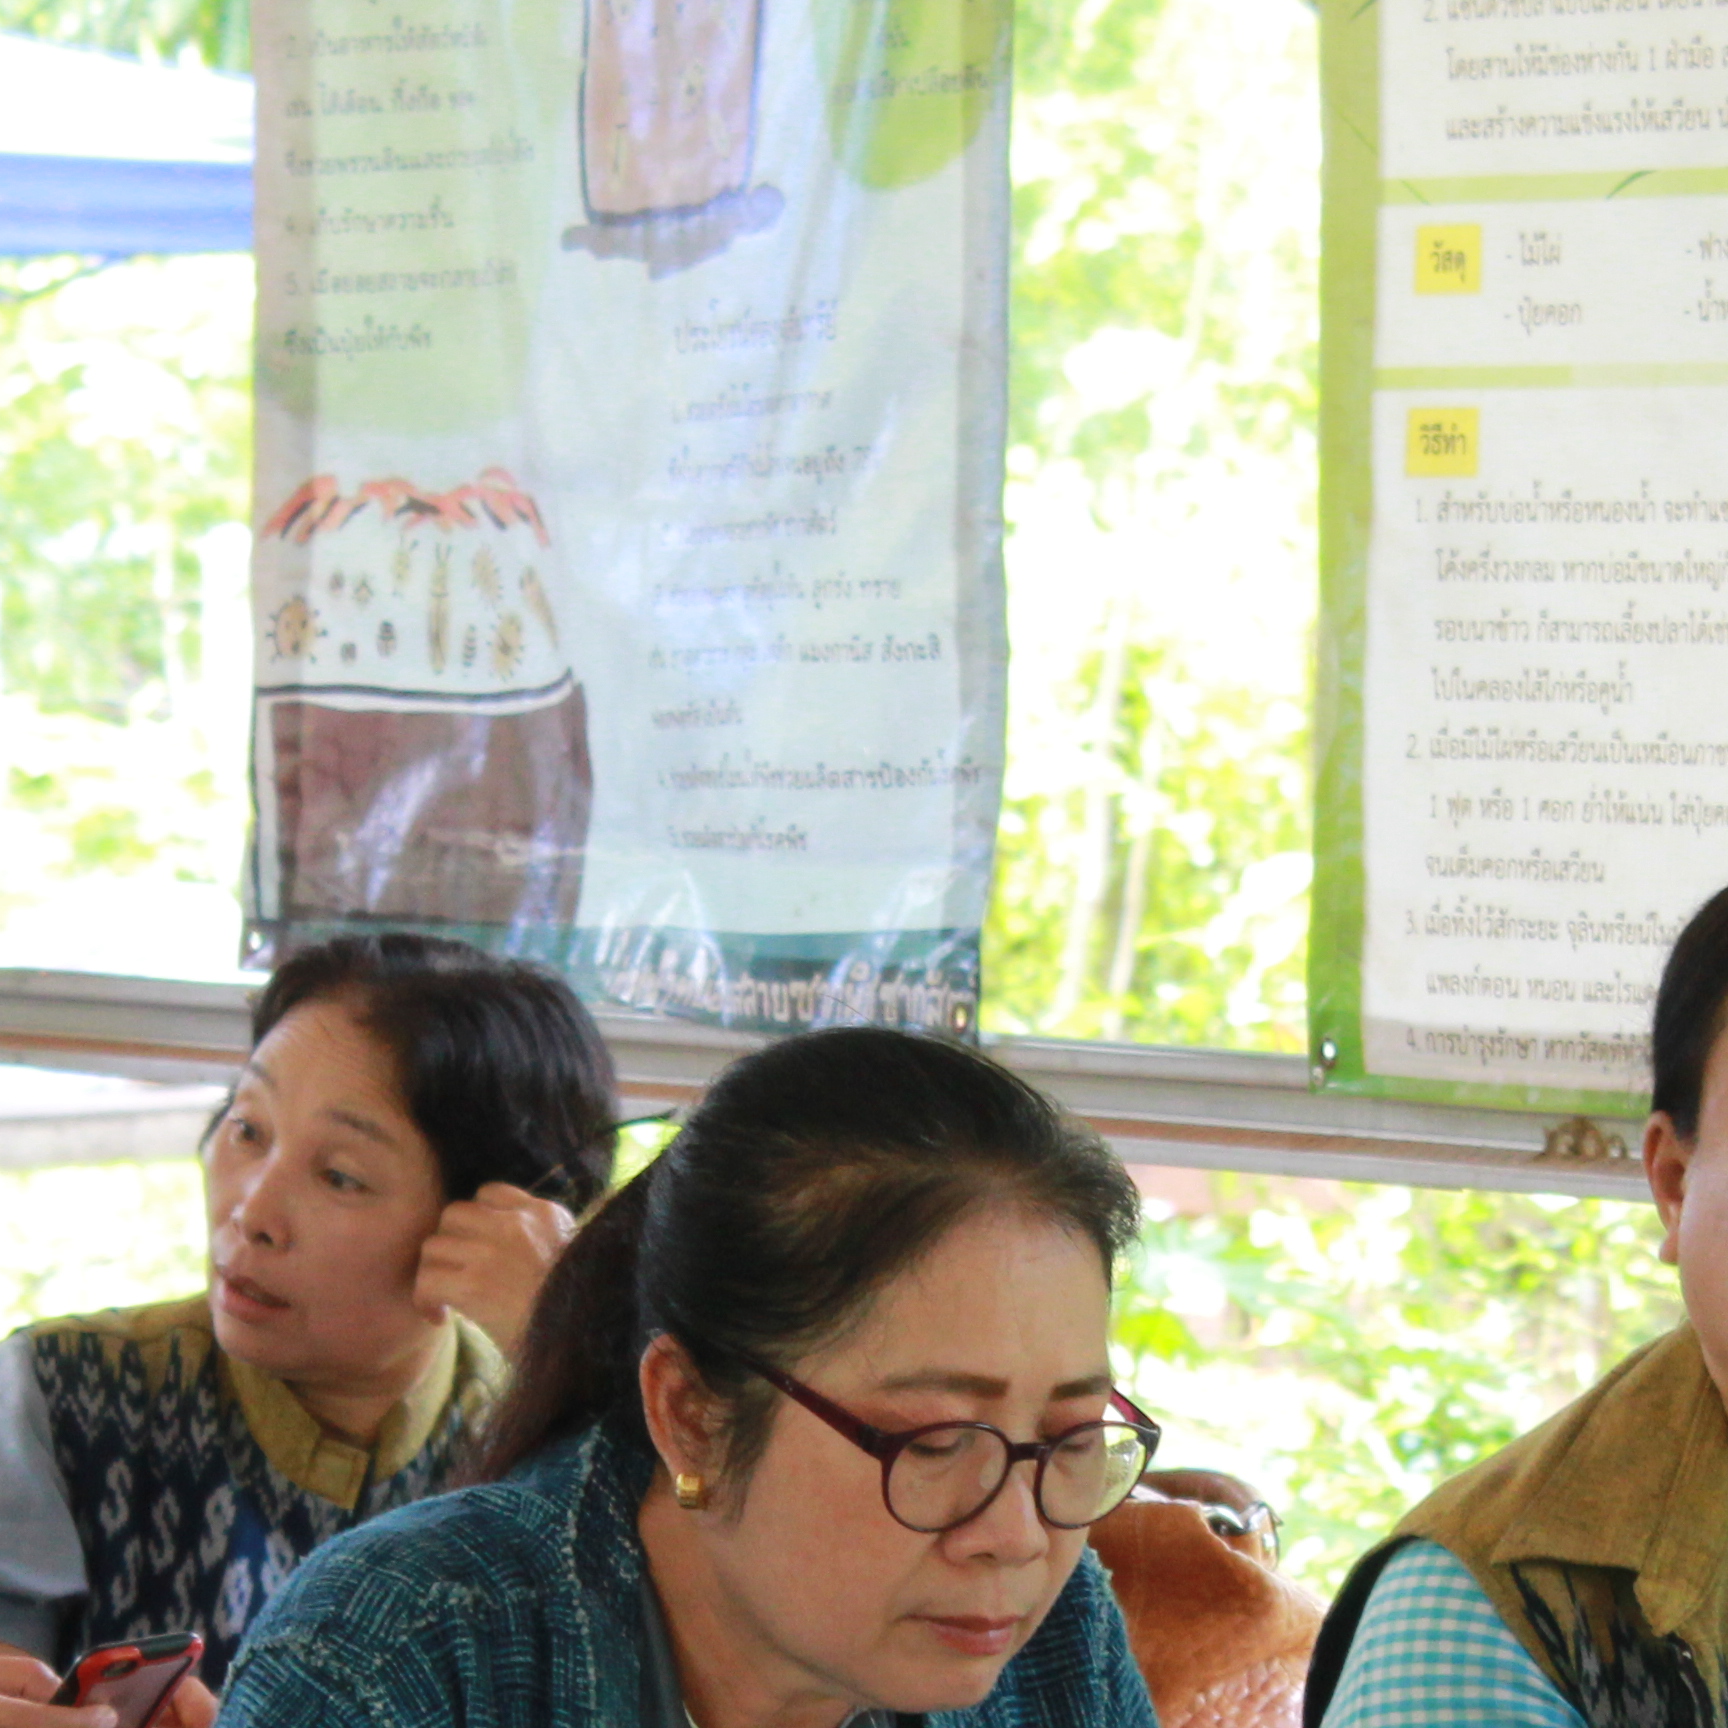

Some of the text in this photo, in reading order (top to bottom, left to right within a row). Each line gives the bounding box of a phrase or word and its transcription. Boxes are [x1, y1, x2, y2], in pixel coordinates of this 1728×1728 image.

[1649, 45, 1657, 72] 1
[1429, 238, 1466, 285] วัสดุ
[1519, 231, 1563, 266] ไม้ไผ่
[1518, 294, 1583, 336] ปุ๋ยคอก
[1419, 421, 1466, 456] วิธีทำ
[1429, 793, 1437, 819] 1
[1446, 789, 1472, 830] ฟุต
[1479, 786, 1513, 822] หรือ
[1522, 795, 1529, 821] 1
[1527, 978, 1575, 1001] หนอน
